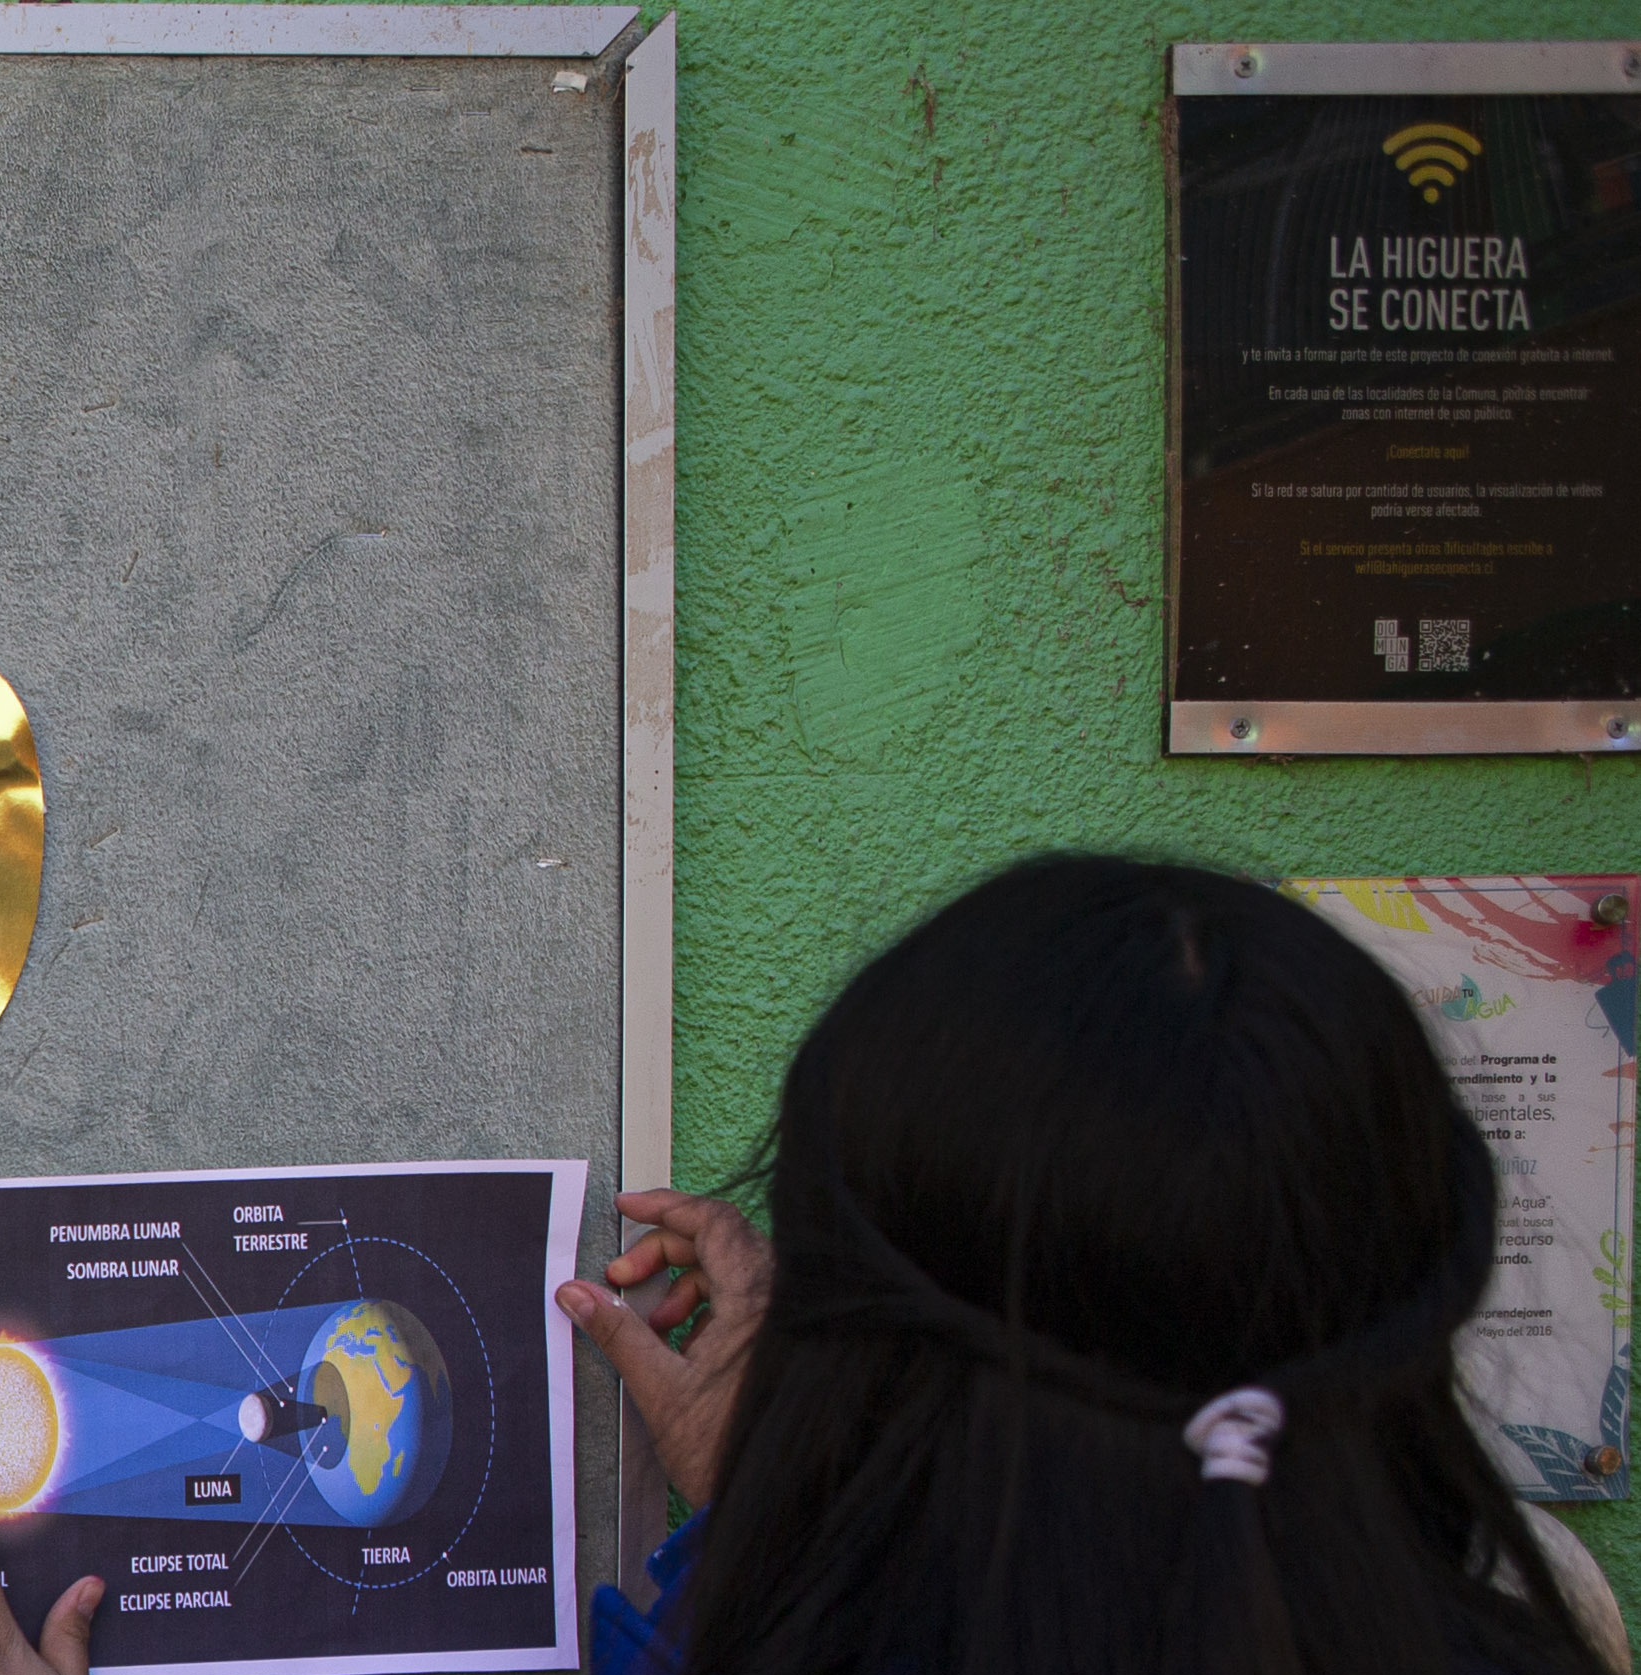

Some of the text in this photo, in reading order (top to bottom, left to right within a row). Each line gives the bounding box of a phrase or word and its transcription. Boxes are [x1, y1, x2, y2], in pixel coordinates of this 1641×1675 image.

[1330, 236, 1527, 279] LA HIGUERA
[1329, 288, 1530, 331] SE CONECTA
[1242, 350, 1248, 365] y
[1251, 347, 1260, 361] te
[1264, 347, 1292, 361] invita
[1294, 350, 1301, 361] a
[1304, 347, 1337, 361] formar
[1340, 348, 1366, 365] parte
[1370, 347, 1382, 361] de
[1385, 348, 1407, 361] este
[1410, 348, 1454, 365] proyecto
[1456, 347, 1469, 361] de
[1520, 348, 1560, 365] gratuita
[1562, 350, 1569, 361] a
[1269, 385, 1282, 400] En
[1284, 385, 1308, 400] cada
[1311, 388, 1330, 400] una
[1332, 385, 1345, 400] de
[1348, 385, 1363, 400] las
[1366, 385, 1424, 400] localidades
[1427, 386, 1440, 400] de
[1443, 386, 1452, 400] la
[1455, 386, 1499, 402] Comuna,
[1539, 387, 1588, 400] encontrar
[1341, 407, 1514, 423] zonas con internet de uso público.
[1251, 482, 1262, 498] Si
[1264, 483, 1274, 498] la
[1277, 483, 1292, 498] red
[1296, 486, 1308, 498] se
[1310, 484, 1342, 498] satura
[1345, 486, 1361, 501] por
[1365, 483, 1408, 498] cantidad
[1411, 483, 1423, 498] de
[1427, 484, 1473, 499] usuarios,
[1476, 484, 1486, 498] la
[1488, 483, 1553, 498] visualización
[1556, 484, 1568, 498] de
[1371, 503, 1483, 520] podría verse afectada.
[1299, 539, 1310, 556] Si
[1312, 540, 1323, 556] el
[1325, 541, 1365, 556] servicio
[1367, 543, 1412, 558] presenta
[1415, 543, 1441, 556] otras
[1462, 988, 1474, 998] TU
[1464, 993, 1516, 1020] AGUA
[1460, 1055, 1476, 1066] del
[1480, 1055, 1539, 1067] Programa
[1541, 1054, 1557, 1064] de
[1530, 1074, 1537, 1085] y
[1544, 1072, 1556, 1083] la
[1481, 1093, 1506, 1103] base
[1518, 1094, 1525, 1102] a
[1537, 1093, 1556, 1102] sus
[1466, 1105, 1555, 1122] bientales,
[1480, 1128, 1526, 1140] ento a:
[233, 1205, 284, 1223] ORBITA
[1523, 1217, 1554, 1228] busca
[49, 1221, 181, 1243] PENUMBRA LUNAR
[1499, 1235, 1554, 1246] recurso
[233, 1233, 309, 1252] TERRESTRE
[66, 1258, 179, 1280] SOMBRA LUNAR
[1476, 1325, 1553, 1339] Mayo del 2016
[194, 1480, 232, 1498] LUNA
[131, 1553, 230, 1574] ECLIPSE TOTAL
[361, 1546, 411, 1565] TIERRA
[446, 1567, 548, 1588] ORBITA LUNAR
[119, 1590, 232, 1612] ECLIPSE PARCIAL
